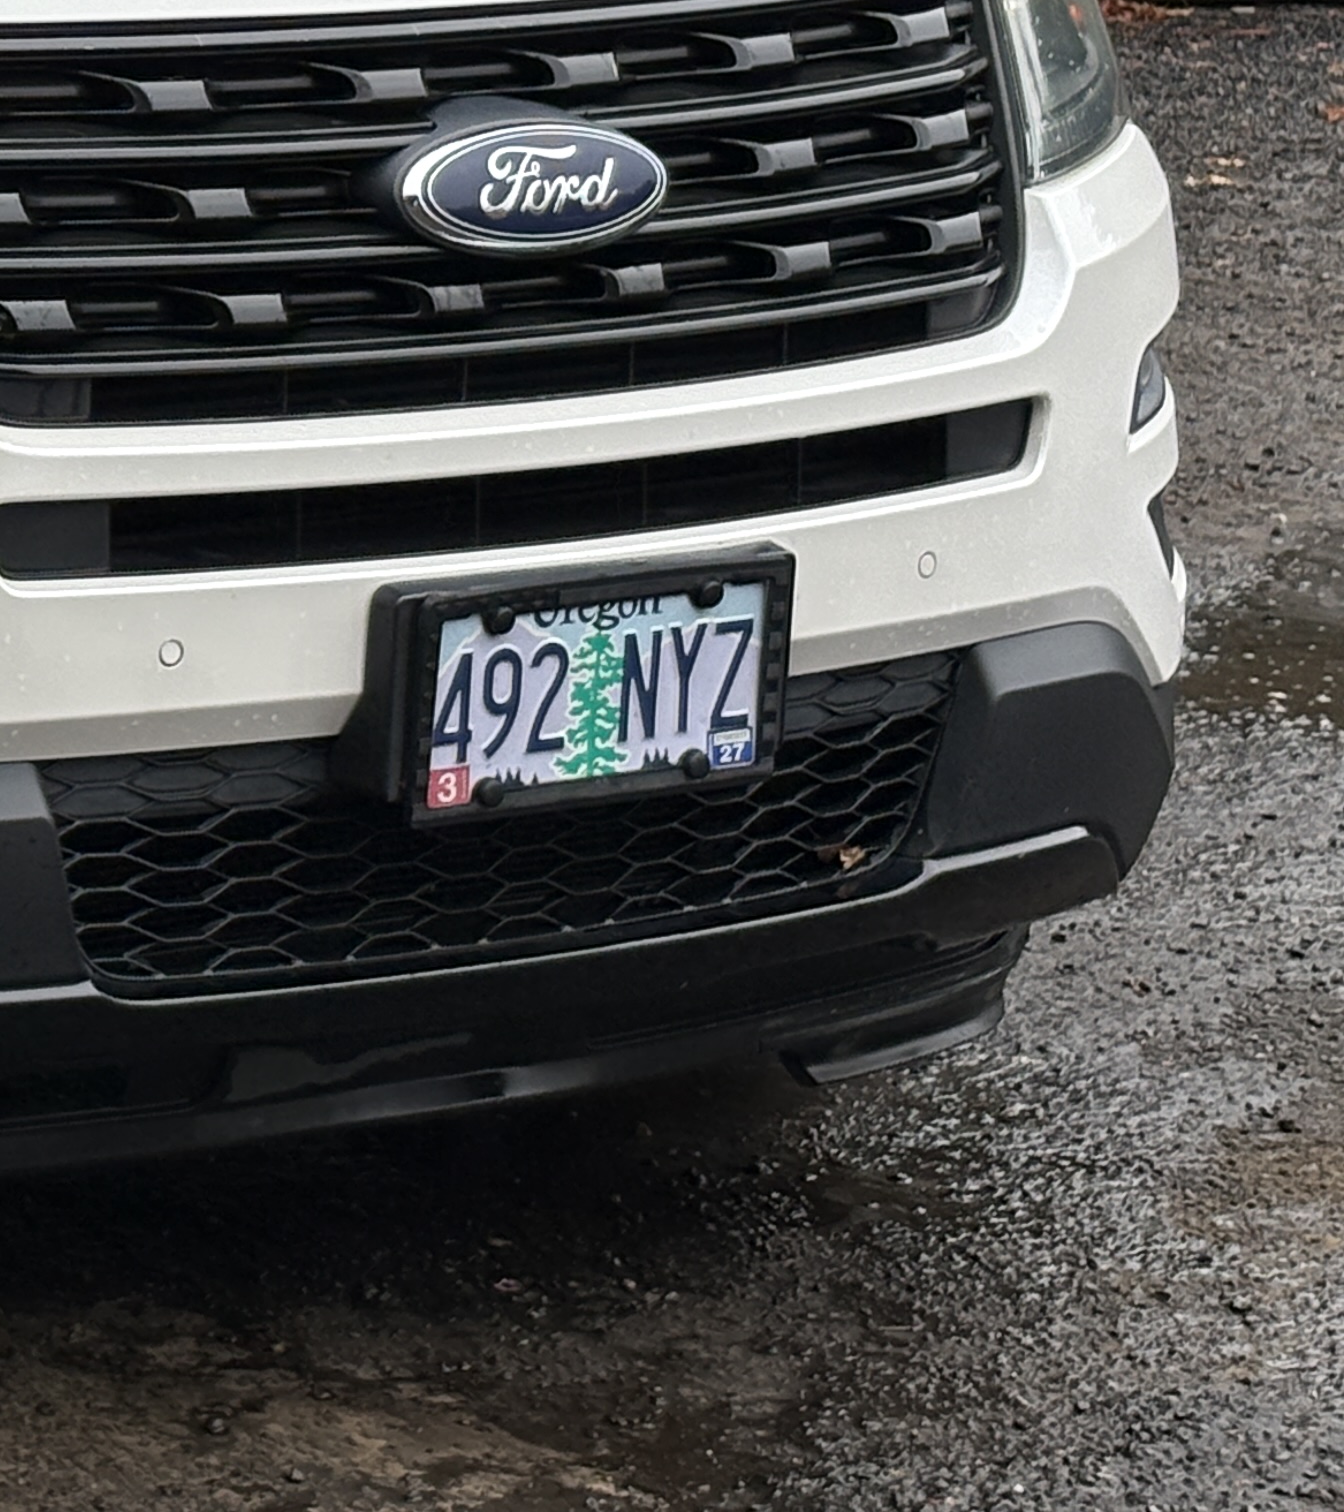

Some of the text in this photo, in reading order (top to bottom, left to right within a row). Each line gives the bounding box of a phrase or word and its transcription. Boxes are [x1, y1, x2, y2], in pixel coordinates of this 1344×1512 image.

[479, 144, 619, 216] Ford
[432, 617, 754, 764] 492 NYZ
[719, 742, 746, 763] 27
[437, 772, 457, 803] 3
